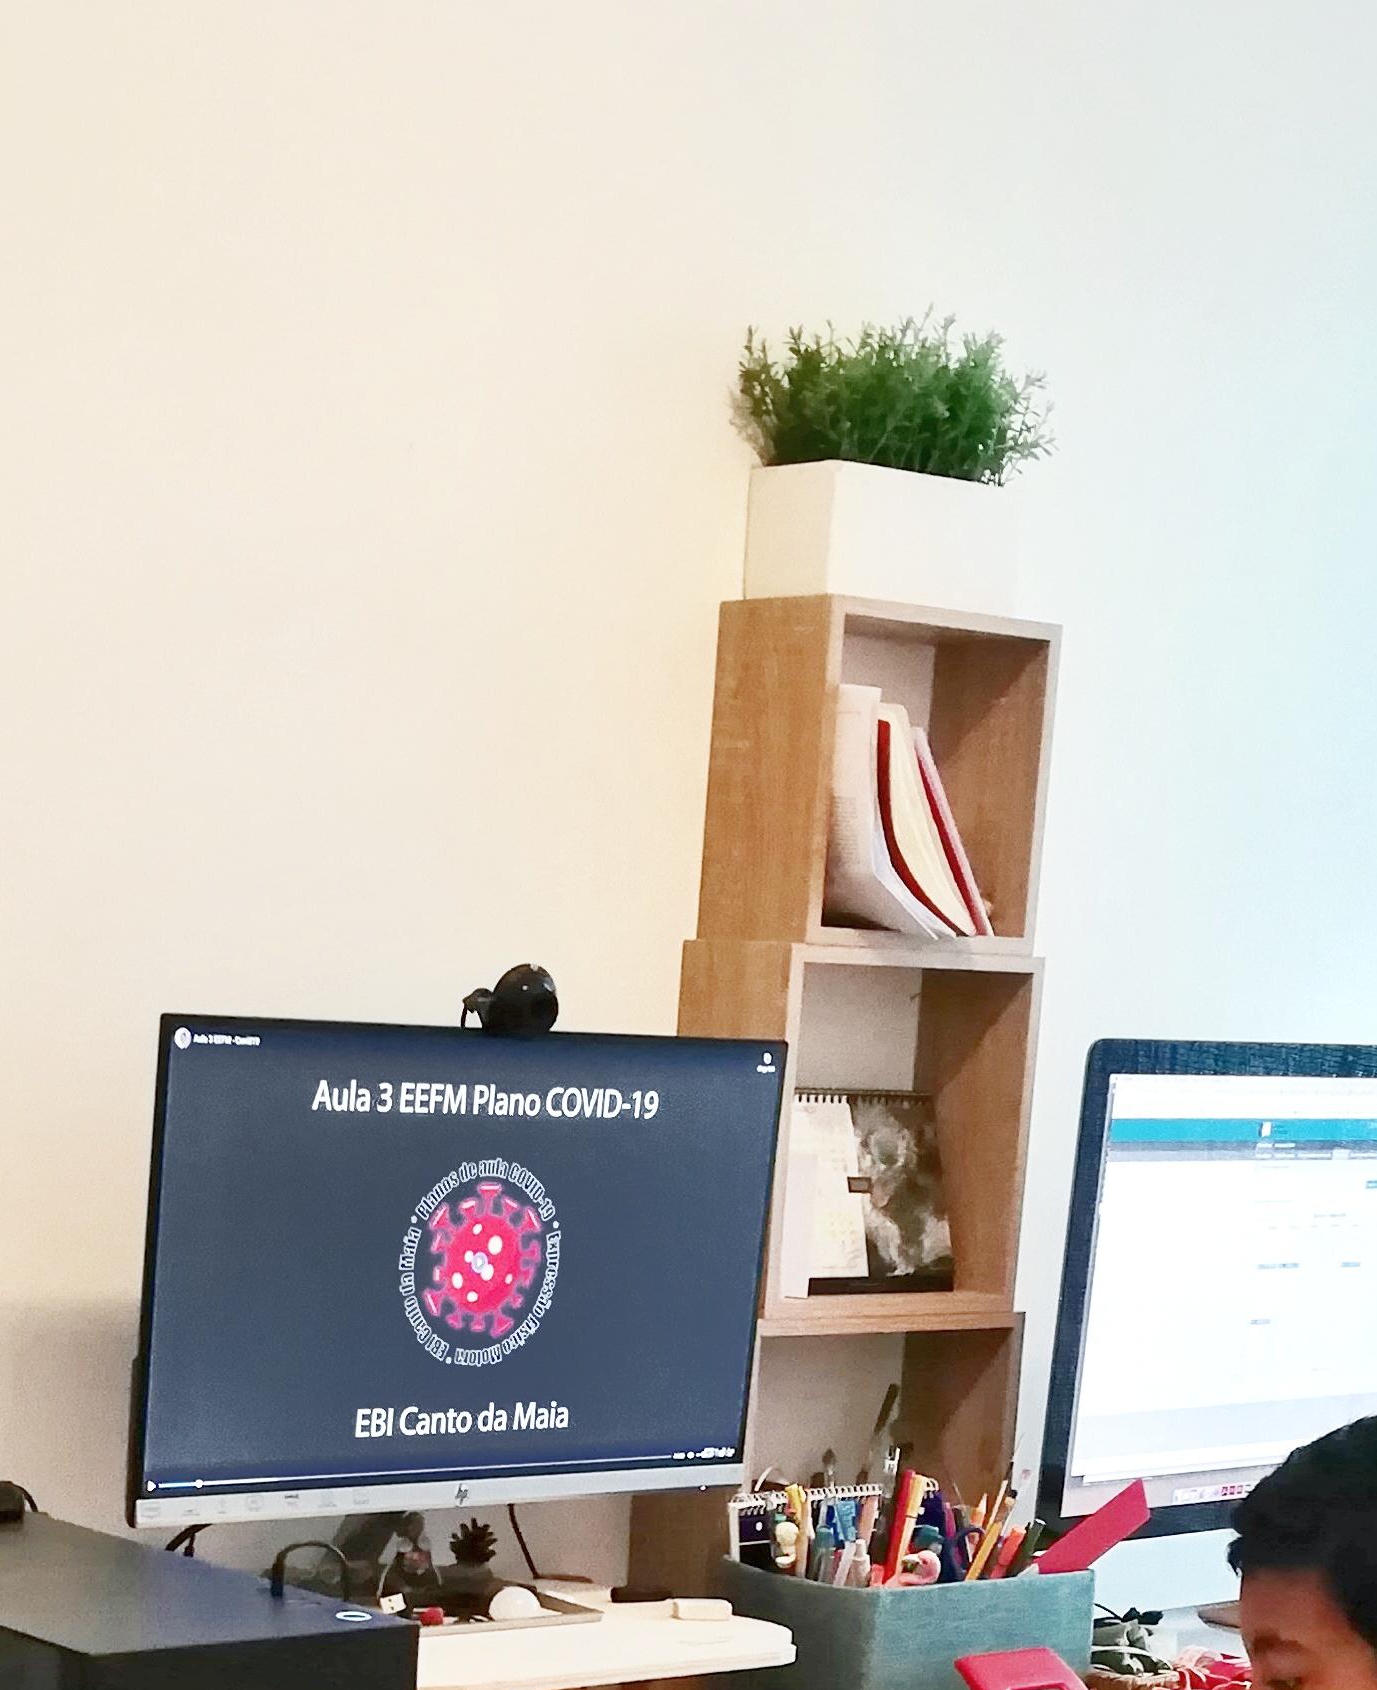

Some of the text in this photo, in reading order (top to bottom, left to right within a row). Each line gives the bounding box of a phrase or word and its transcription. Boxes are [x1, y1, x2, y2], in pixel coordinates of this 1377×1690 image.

[311, 1079, 659, 1120] Aula 3 EEFM Plano COVID-19
[415, 1158, 555, 1221] Planos de aula COVID-19
[398, 1226, 423, 1271] Maia
[399, 1271, 416, 1297] da
[355, 1401, 569, 1438] EBI Canto da Maia
